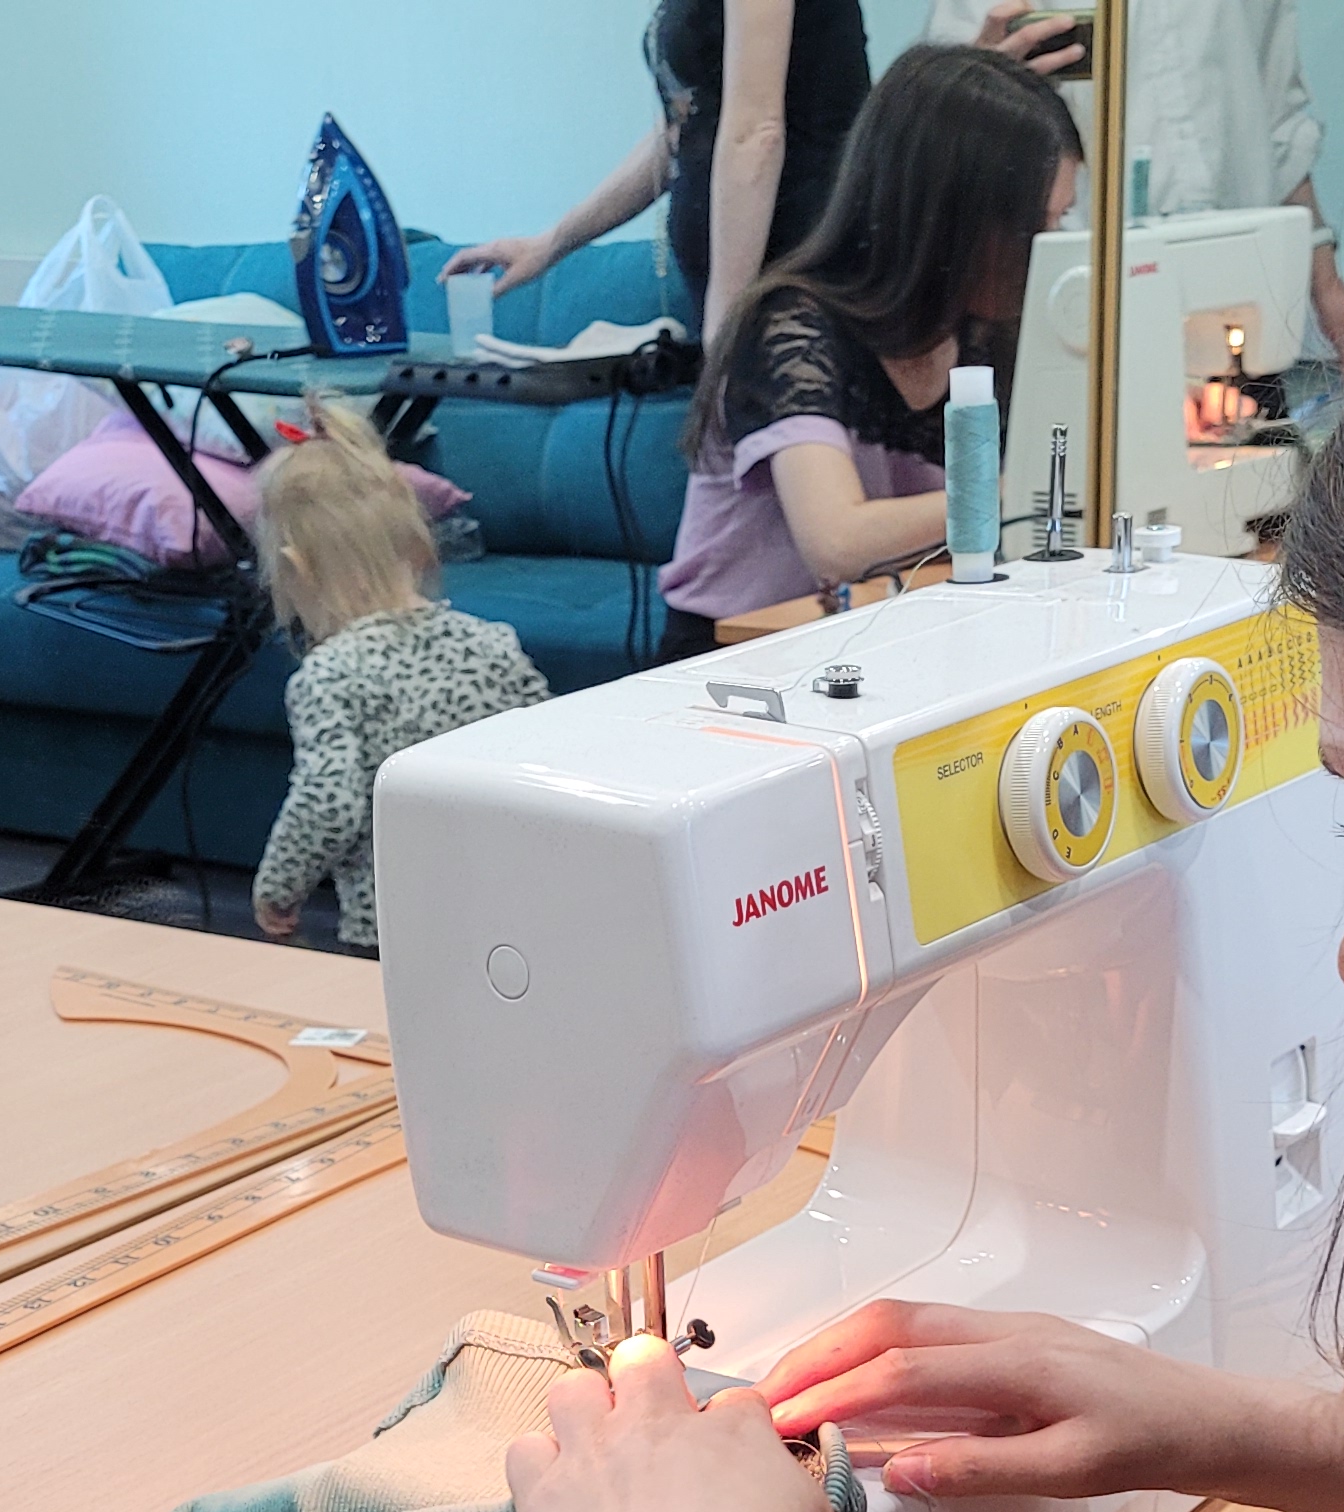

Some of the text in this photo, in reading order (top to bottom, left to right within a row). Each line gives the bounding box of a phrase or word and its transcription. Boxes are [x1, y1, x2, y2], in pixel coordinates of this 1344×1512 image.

[1073, 724, 1079, 736] A
[937, 752, 984, 780] SELECTOR
[1066, 846, 1071, 859] E
[732, 865, 829, 927] JANOME
